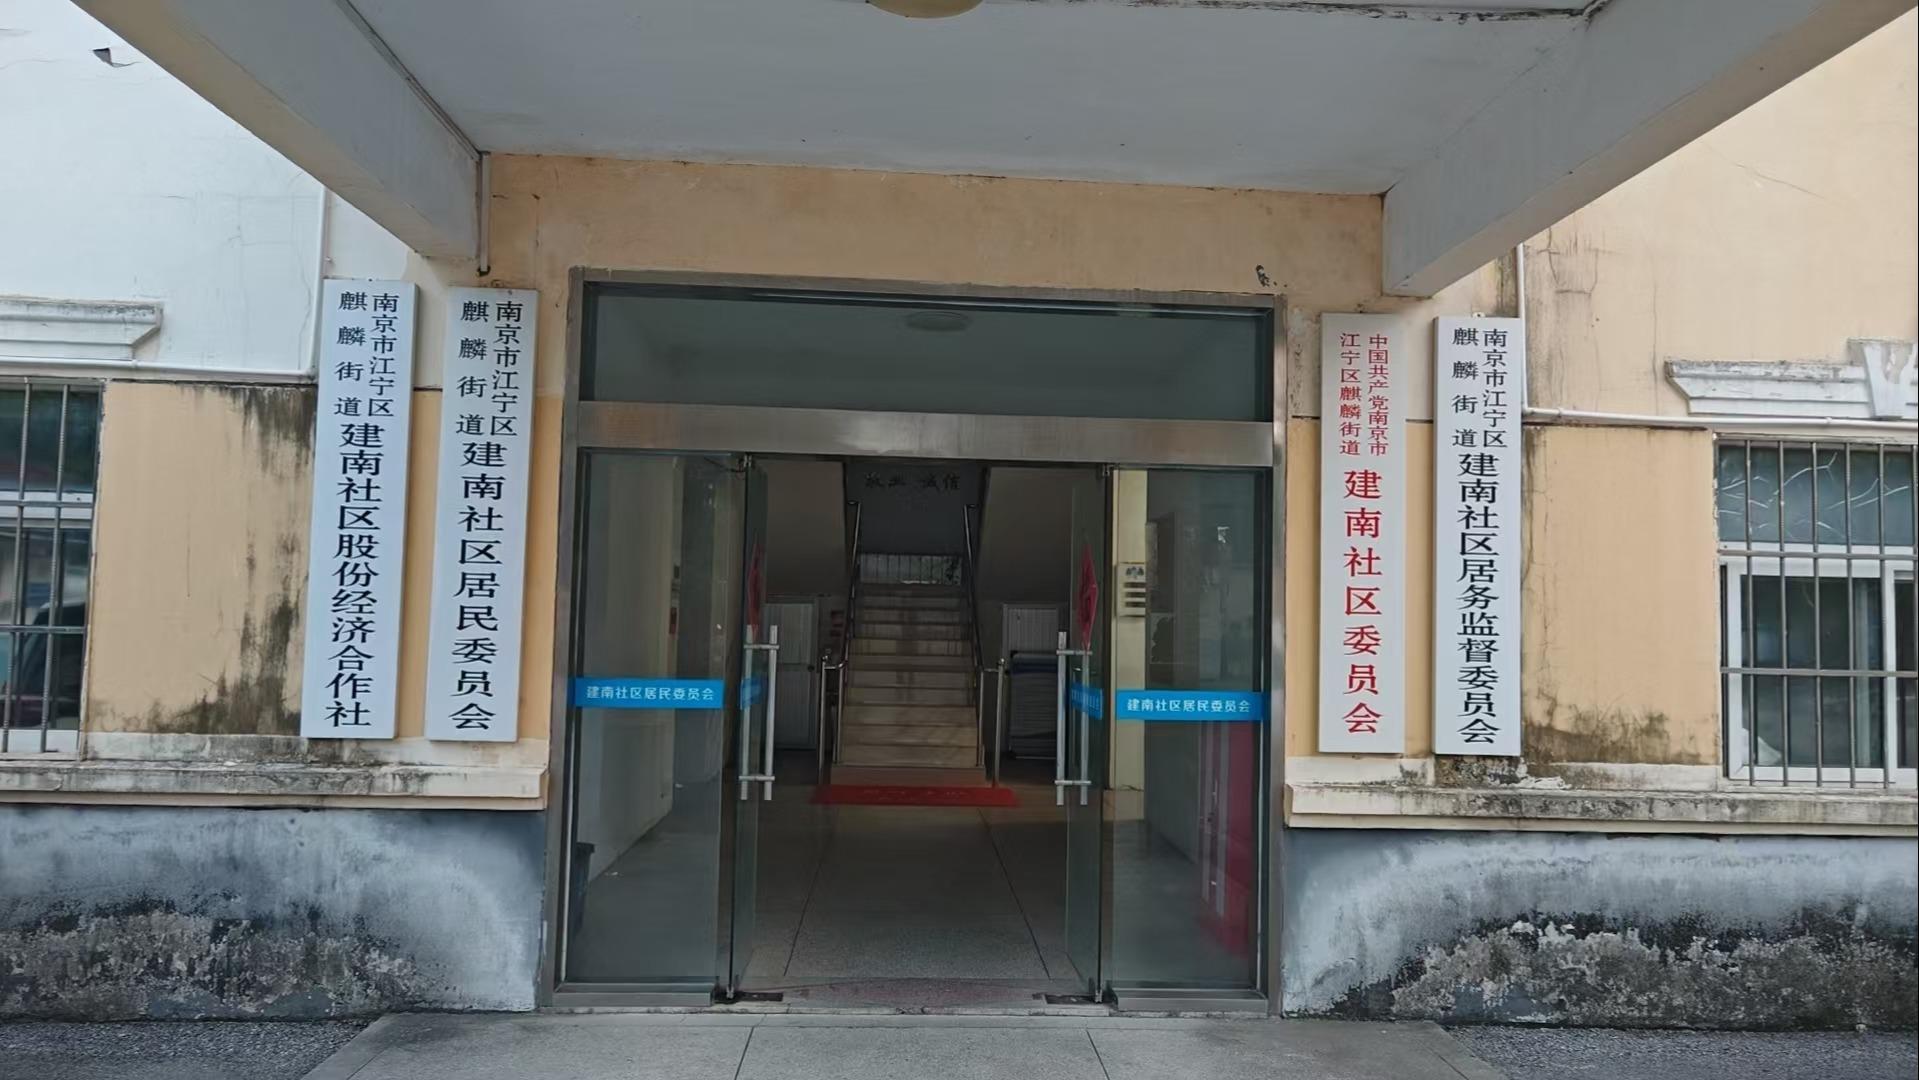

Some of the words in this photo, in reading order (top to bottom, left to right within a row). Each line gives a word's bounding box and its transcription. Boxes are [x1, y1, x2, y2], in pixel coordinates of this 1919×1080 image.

[333, 291, 368, 417] 麒麟街道
[367, 294, 400, 417] 南京市江宁区
[455, 300, 489, 436] 麒麟街道
[490, 301, 524, 436] 南京市江宁区
[1339, 332, 1362, 456] 江宁区麒麟街道
[1367, 334, 1389, 456] 中国共产党南京市
[1451, 327, 1479, 448] 麒麟街道
[1482, 328, 1508, 448] 南京市江宁区
[324, 422, 386, 728] 建南社区股份经济合作社
[448, 441, 508, 730] 建南社区居民委员会
[1342, 469, 1383, 734] 建南社区委员会
[1456, 452, 1501, 744] 建南社区居务监督委员会
[586, 685, 715, 701] 建南社区居民委员会
[1127, 698, 1251, 713] 建南社区居民委员会
